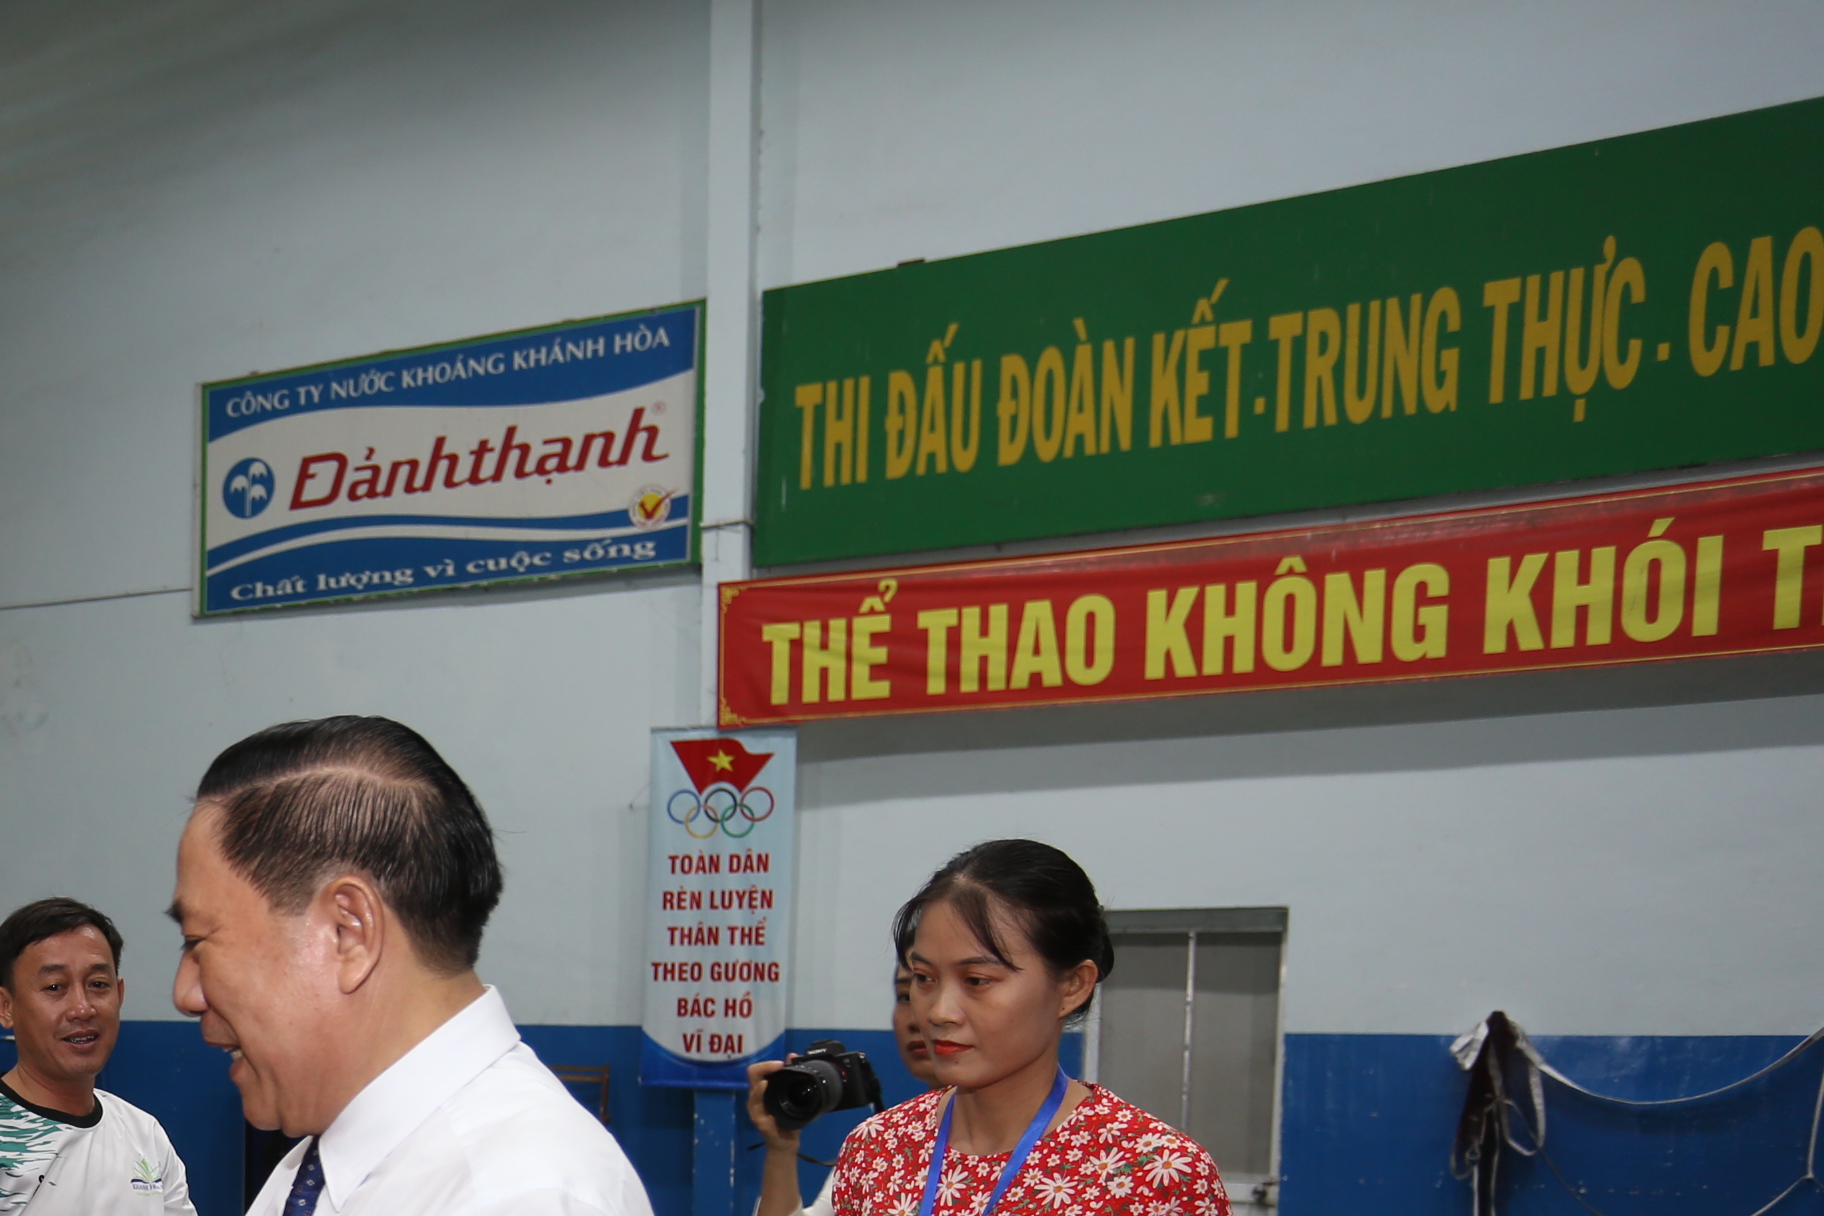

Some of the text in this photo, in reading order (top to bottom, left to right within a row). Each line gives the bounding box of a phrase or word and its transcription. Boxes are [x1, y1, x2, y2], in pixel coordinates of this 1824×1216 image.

[225, 324, 670, 418] CÔNG TY NƯỚC KHOÁNG KHÁNH HÒA
[794, 374, 870, 491] THI
[884, 322, 982, 480] ĐẤU
[996, 317, 1136, 467] ĐOÀN
[1483, 235, 1646, 424] THỰC
[1688, 226, 1824, 378] CAO
[230, 536, 657, 602] Chất lượng vì cuộc sống
[762, 579, 898, 705] THỂ
[916, 593, 1116, 696] THAO
[1145, 555, 1450, 681] KHÔNG
[1483, 517, 1724, 655] KHÓI
[668, 849, 770, 875] TOÀN DÂN
[663, 886, 773, 914] RÈN LUYỆN
[667, 917, 767, 946] THÂN THỂ
[651, 960, 780, 983] THEO GƯƠNG
[677, 991, 753, 1018] BÁC HỒ
[682, 1031, 744, 1059] VĨ ĐẠI
